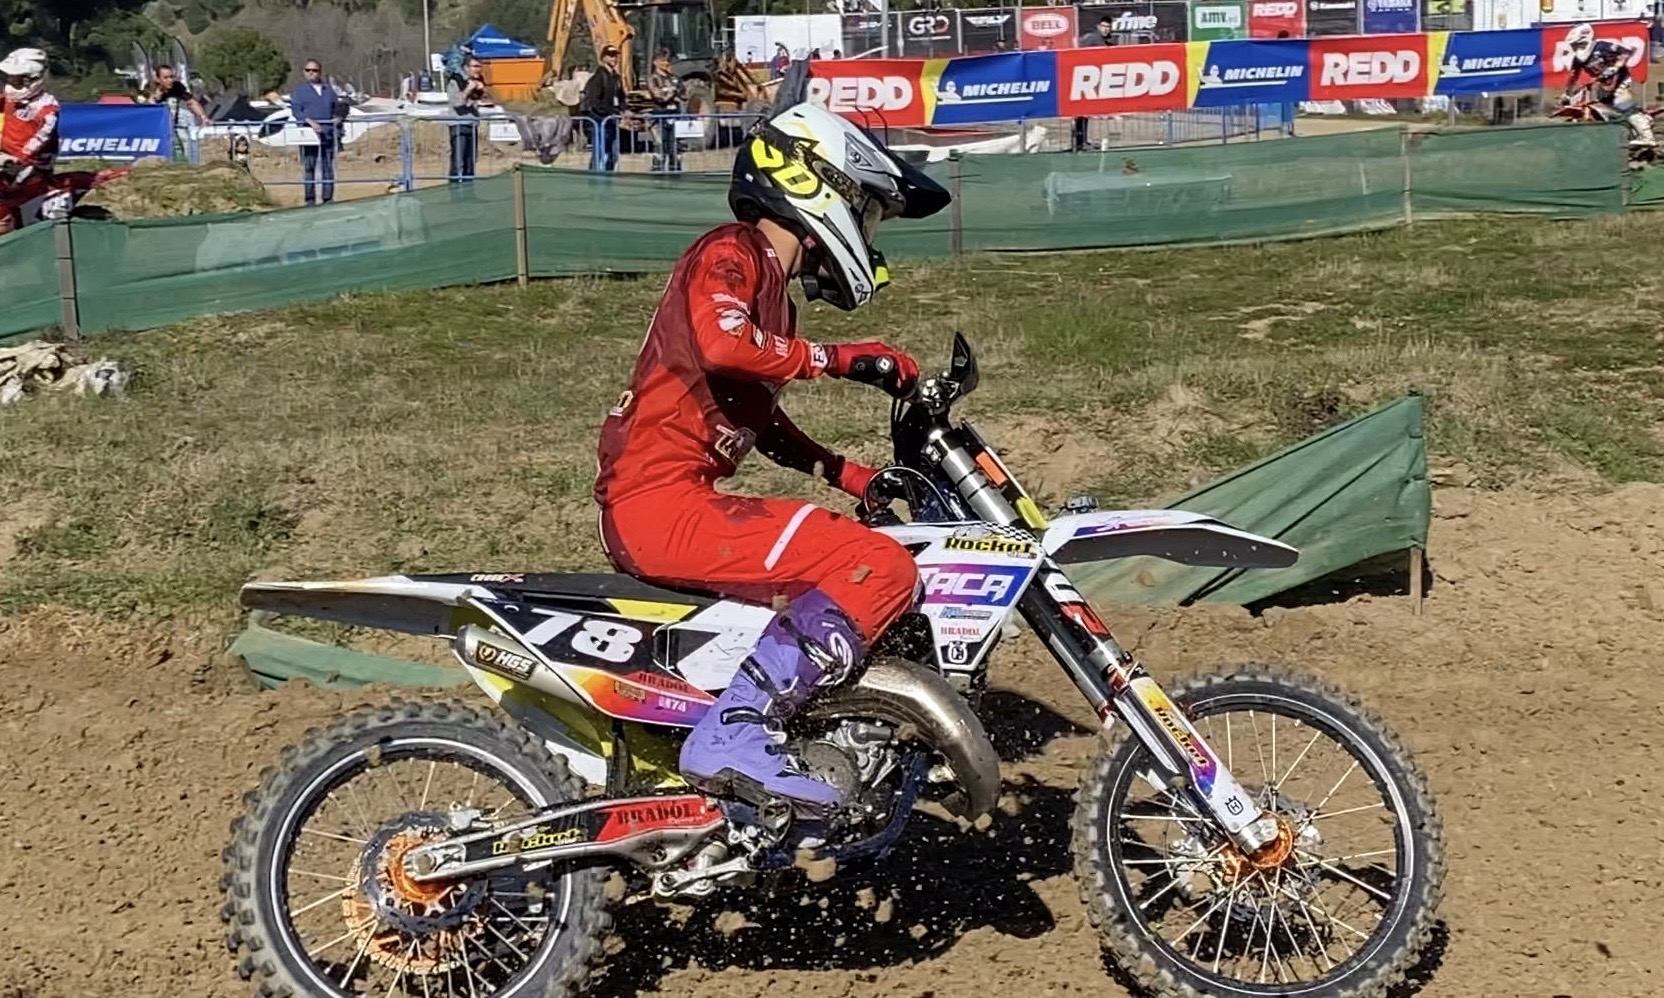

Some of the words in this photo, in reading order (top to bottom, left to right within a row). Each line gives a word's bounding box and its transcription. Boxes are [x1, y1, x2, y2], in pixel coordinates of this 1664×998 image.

[1032, 20, 1062, 31] BELL
[1461, 53, 1537, 72] MICHELIN
[1552, 36, 1645, 72] RD
[1223, 65, 1304, 81] MICHELIN
[1319, 49, 1421, 86] REDD
[963, 80, 1050, 97] MICHELIN
[1070, 61, 1181, 101] REDD
[806, 76, 914, 113] REDD
[58, 138, 161, 152] ICHELIN
[944, 537, 1033, 553] Rocket
[520, 606, 644, 664] 78
[494, 650, 534, 672] HGS
[617, 801, 695, 826] BRADOL
